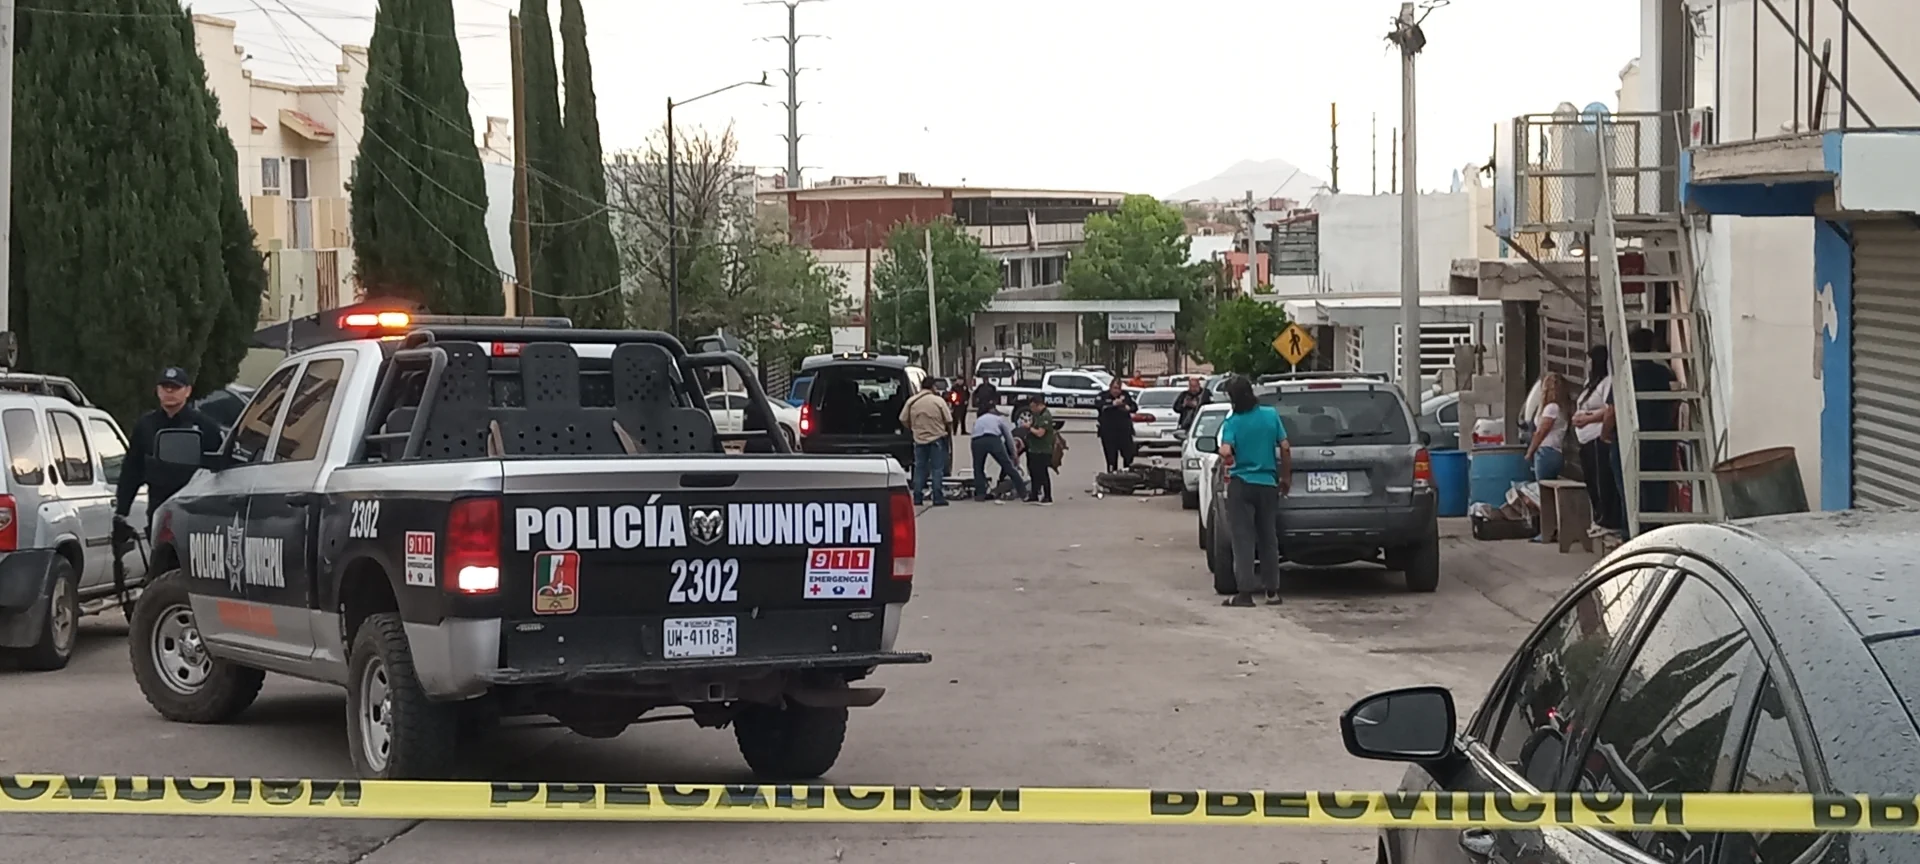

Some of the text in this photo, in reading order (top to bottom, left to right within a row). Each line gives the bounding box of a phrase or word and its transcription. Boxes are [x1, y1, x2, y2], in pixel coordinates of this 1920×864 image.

[350, 500, 380, 538] 2302
[515, 494, 882, 550] POLICÍA MUNICIPAL
[189, 525, 286, 588] POLICÍA MUNICIPAL
[408, 536, 432, 553] 911
[813, 552, 866, 568] 911
[669, 559, 739, 603] 2302
[667, 628, 734, 647] UW-4118-A
